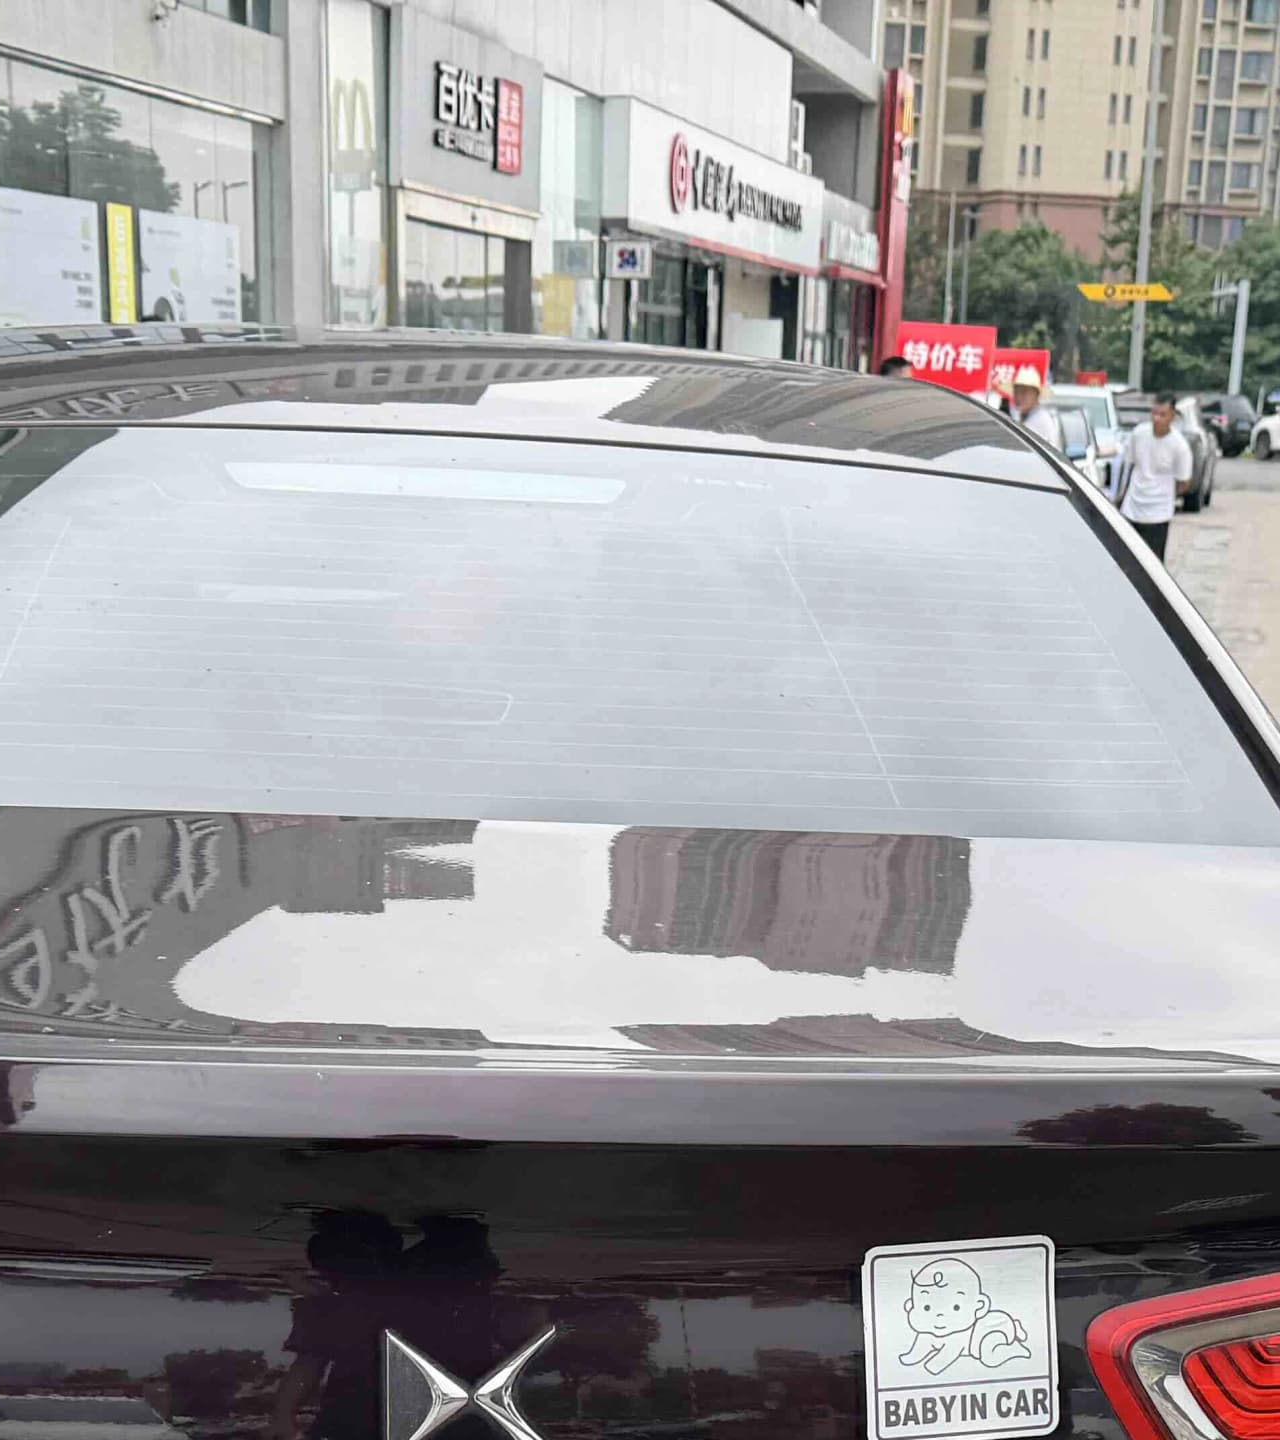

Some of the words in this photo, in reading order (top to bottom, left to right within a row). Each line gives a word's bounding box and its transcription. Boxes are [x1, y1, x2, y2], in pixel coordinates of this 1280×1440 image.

[902, 341, 985, 375] 特价车
[995, 1387, 1050, 1418] CAR
